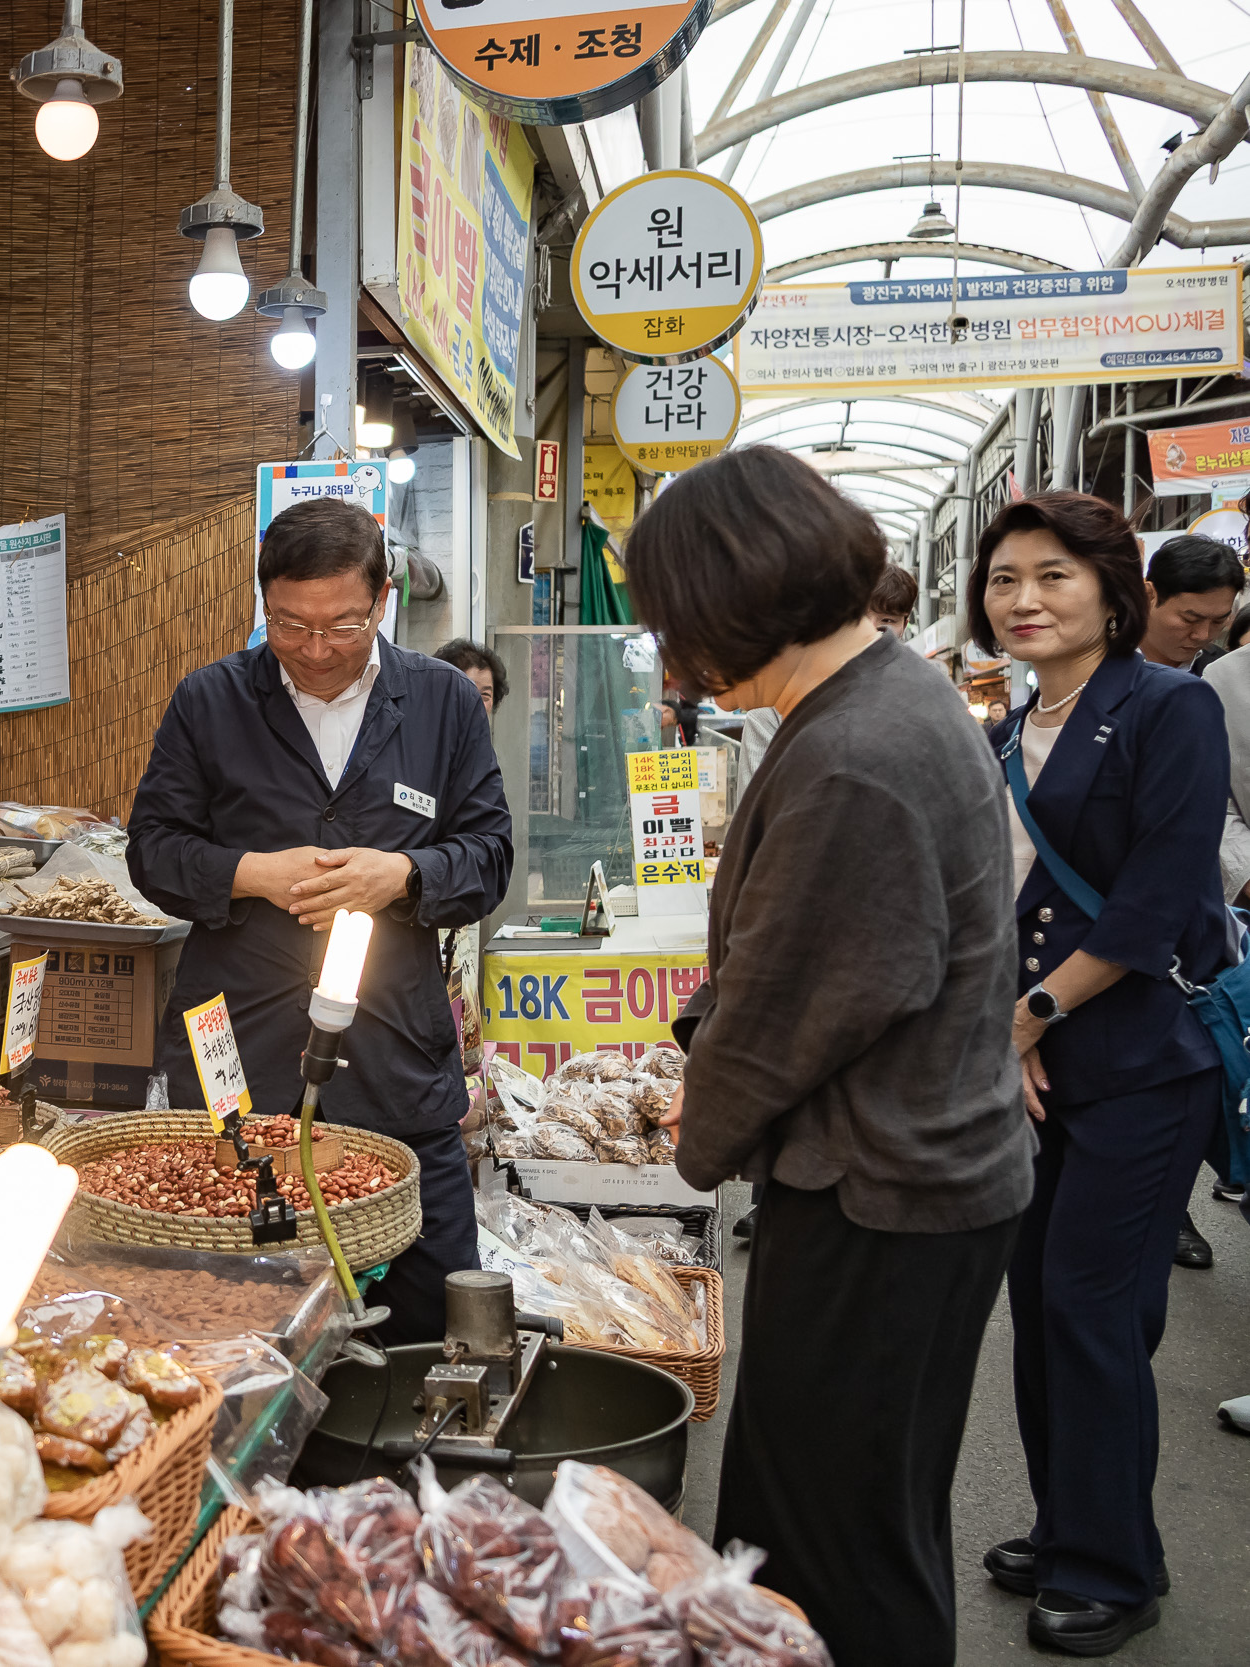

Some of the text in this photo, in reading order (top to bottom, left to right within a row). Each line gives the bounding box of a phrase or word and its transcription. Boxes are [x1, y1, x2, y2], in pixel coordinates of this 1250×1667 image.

[474, 22, 643, 72] 수제 조청
[647, 206, 683, 249] 원
[589, 248, 742, 300] 악세서리
[1165, 275, 1229, 289] 오석한방병원
[861, 285, 903, 301] 광진구
[966, 277, 1008, 298] 발전과
[1012, 276, 1083, 296] 건강증진을
[1086, 275, 1115, 292] 위한
[643, 315, 686, 339] 잡화
[1017, 308, 1226, 340] 업무협약(MOU)체결
[1105, 350, 1218, 365] 예약문의 02.454.7582
[909, 362, 939, 374] 구의역
[645, 367, 708, 401] 건강
[644, 401, 707, 432] 나라
[636, 444, 711, 461] 홍삼·한약달임
[291, 484, 354, 497] 누구나 365일
[9, 536, 32, 550] 원산지
[634, 751, 691, 765] 14K 목걸이
[634, 765, 692, 774] 18K 귀걸이
[635, 774, 656, 782] 24K
[635, 781, 693, 792] 무조건 다 삽니다
[652, 794, 680, 816] 금
[642, 817, 695, 835] 이빨
[643, 835, 695, 847] 최고가
[643, 847, 696, 859] 삽니다
[642, 861, 701, 884] 은수저
[58, 976, 86, 986] 900ml
[497, 974, 571, 1021] 18K
